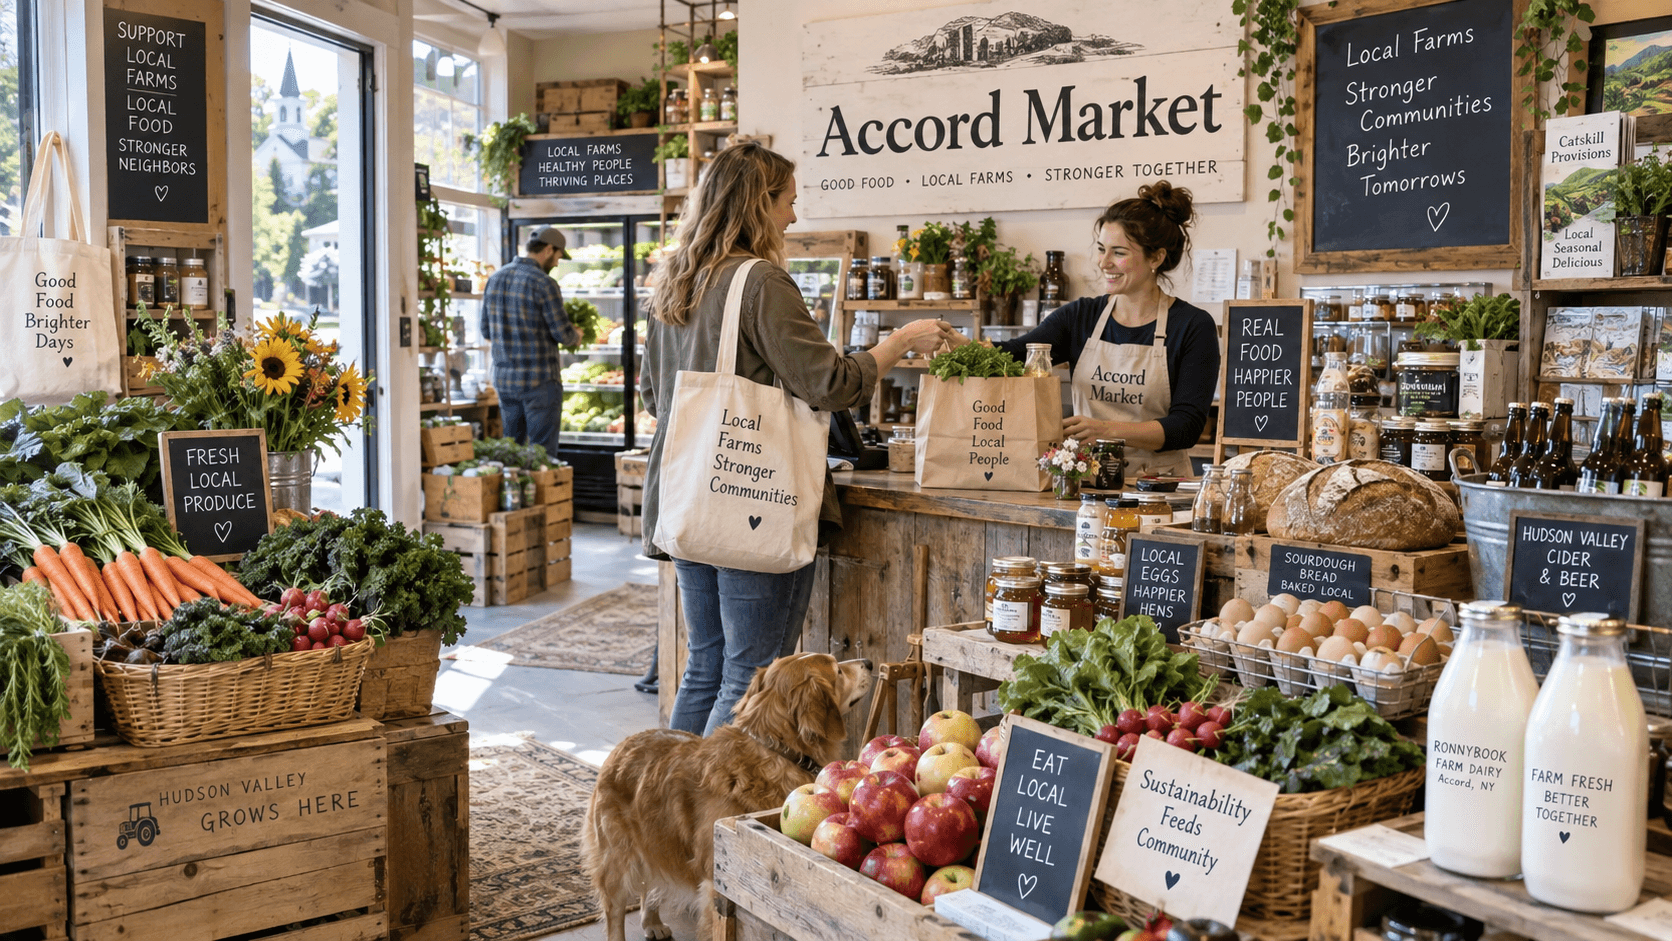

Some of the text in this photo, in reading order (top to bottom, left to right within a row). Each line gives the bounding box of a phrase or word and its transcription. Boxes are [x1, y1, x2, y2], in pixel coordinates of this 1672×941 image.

[118, 21, 186, 48] SUPPORT
[1347, 27, 1474, 67] Local Farms
[127, 46, 176, 69] LOCAL
[127, 68, 177, 90] FARMS
[1345, 76, 1437, 105] Stronger
[127, 95, 176, 115] LOCAL
[1360, 95, 1493, 132] Communities
[129, 115, 173, 134] FOOD
[816, 75, 1222, 157] Accord Market
[119, 138, 187, 157] STRONGER
[1559, 131, 1605, 148] Catskill
[548, 143, 621, 158] LOCAL FARMS
[1346, 138, 1431, 171] Brighter
[1551, 149, 1612, 164] Provisions
[119, 157, 196, 175] NEIGHBORS
[539, 158, 632, 173] HEALTHY PEOPLE
[820, 160, 1217, 191] GOOD FOOD LOCAL FARMS STRONGER TOGETHER
[539, 173, 633, 187] THRIVING PLACES
[1360, 170, 1465, 196] Tomorrows
[1565, 227, 1593, 240] Local
[1554, 240, 1602, 254] Seasonal
[1552, 256, 1603, 268] Delicious
[35, 272, 76, 288] Good
[36, 292, 74, 309] Food
[25, 313, 91, 334] Brighter
[1242, 318, 1284, 336] REAL
[36, 333, 74, 353] Days
[1240, 343, 1282, 361] FOOD
[1091, 365, 1146, 386] Accord
[1234, 368, 1292, 385] HAPPIER
[1089, 384, 1143, 405] Market
[1236, 390, 1288, 408] PEOPLE
[972, 400, 1005, 413] Good
[721, 409, 762, 431] Local
[974, 417, 1003, 430] Food
[718, 431, 762, 455] Farms
[972, 434, 1005, 448] Local
[186, 447, 239, 466] FRESH
[969, 451, 1009, 469] People
[713, 453, 777, 482] Stronger
[190, 471, 242, 489] LOCAL
[710, 476, 798, 506] Communities
[184, 493, 256, 513] PRODUCE
[1523, 526, 1628, 550] HUDSON VALLEY
[1141, 548, 1184, 565] LOCAL
[1285, 552, 1356, 572] SOURDOUGH
[1547, 549, 1591, 567] CIDER
[1141, 566, 1179, 584] EGGS
[1300, 568, 1337, 583] BREAD
[1539, 568, 1599, 589] & BEER
[1134, 585, 1186, 603] HAPPIER
[1281, 580, 1354, 599] BAKED LOCAL
[1139, 602, 1174, 619] HENS
[1434, 740, 1507, 763] RONNYBOOK
[1032, 749, 1069, 775] EAT
[1436, 758, 1502, 778] FARM DAIRY
[159, 772, 306, 807] HUDSON VALLEY
[1438, 773, 1495, 791] Accord, NY
[1532, 768, 1613, 792] FARM FRESH
[1017, 775, 1067, 807] LOCAL
[1140, 769, 1252, 827] Sustainability
[1544, 790, 1589, 809] BETTER
[201, 790, 359, 833] GROWS HERE
[1016, 807, 1054, 835] LIVE
[1160, 806, 1202, 836] Feeds
[1536, 807, 1597, 828] TOGETHER
[1010, 833, 1054, 866] WELL
[1137, 827, 1219, 875] Community
